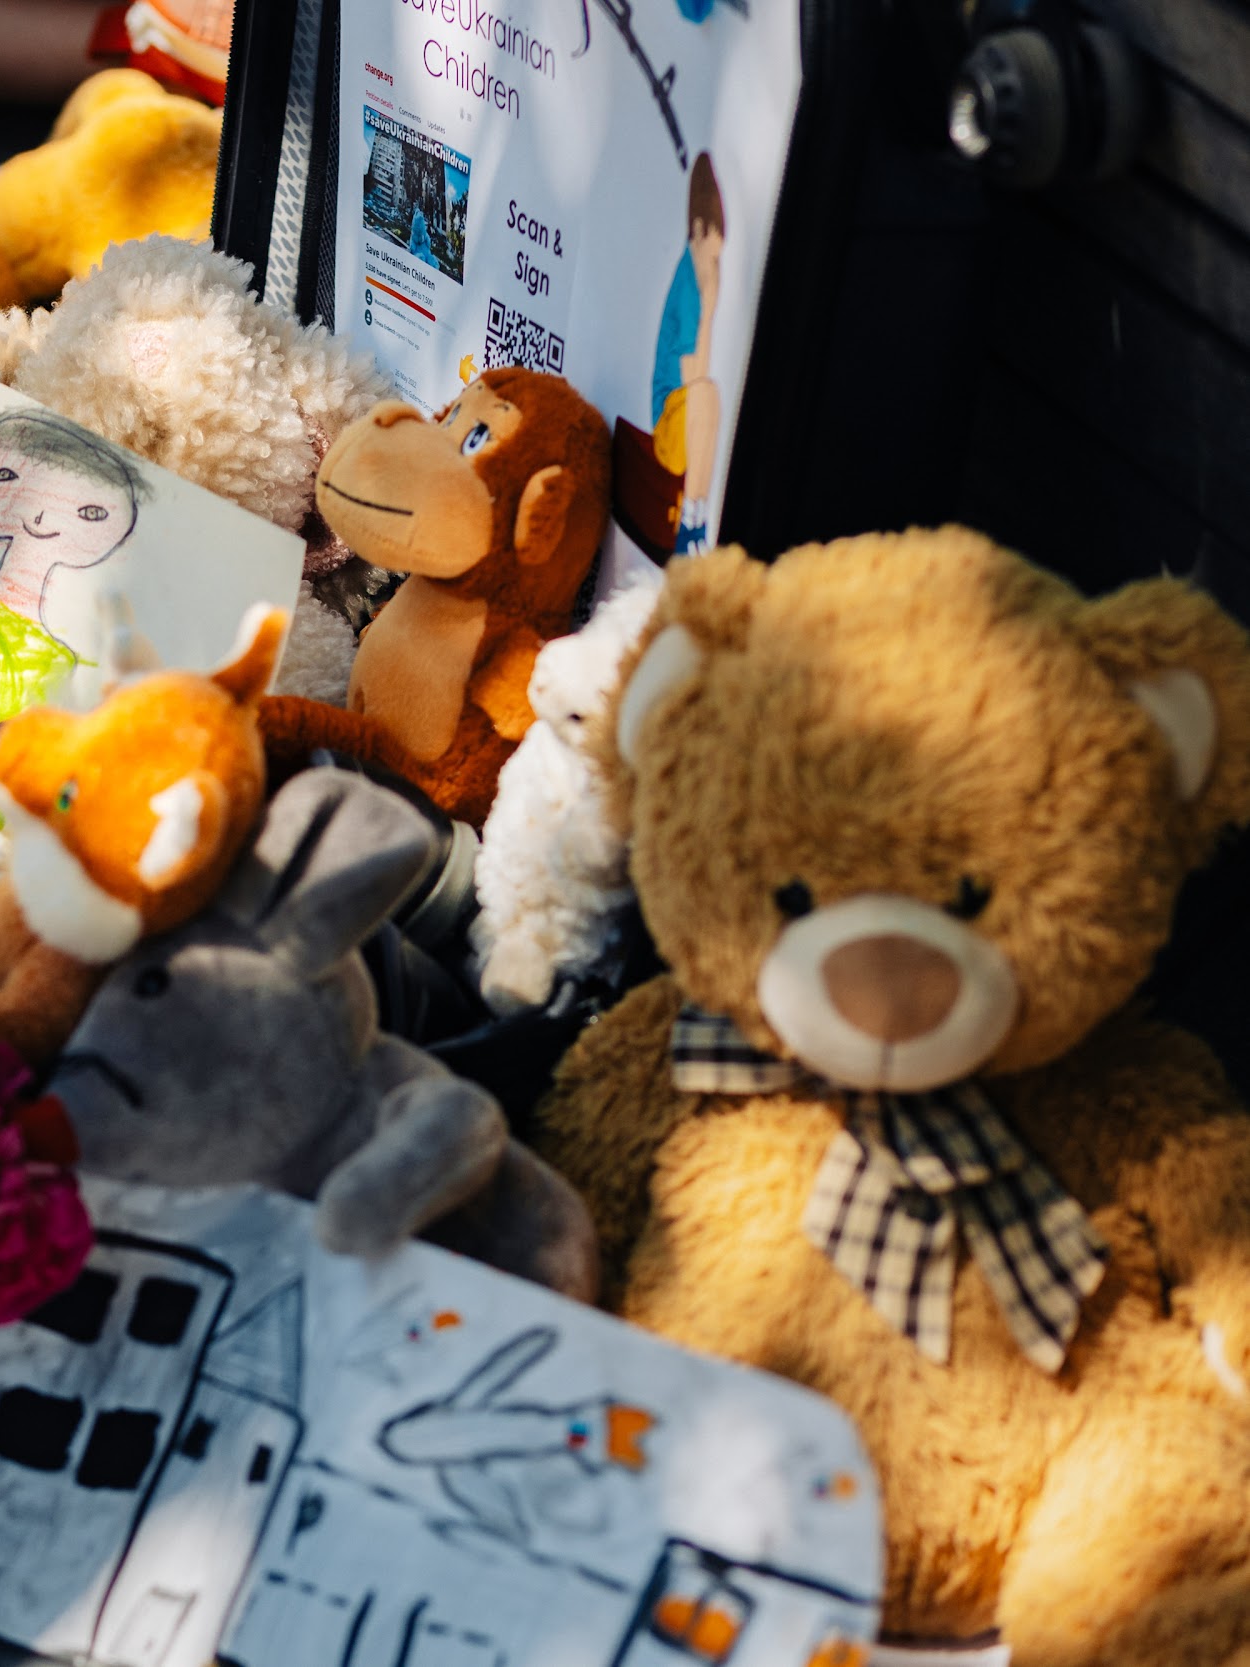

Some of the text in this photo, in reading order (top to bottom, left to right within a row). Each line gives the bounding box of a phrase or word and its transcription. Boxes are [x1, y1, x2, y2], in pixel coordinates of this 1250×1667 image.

[365, 62, 394, 87] change.org
[424, 39, 520, 120] Children
[364, 109, 469, 175] #saveUkrainianChildren
[398, 106, 446, 135] Comments Updates
[507, 199, 563, 259] Scan &
[365, 243, 436, 291] Save Ukrainian Children
[376, 268, 387, 280] have
[514, 251, 550, 297] Sign
